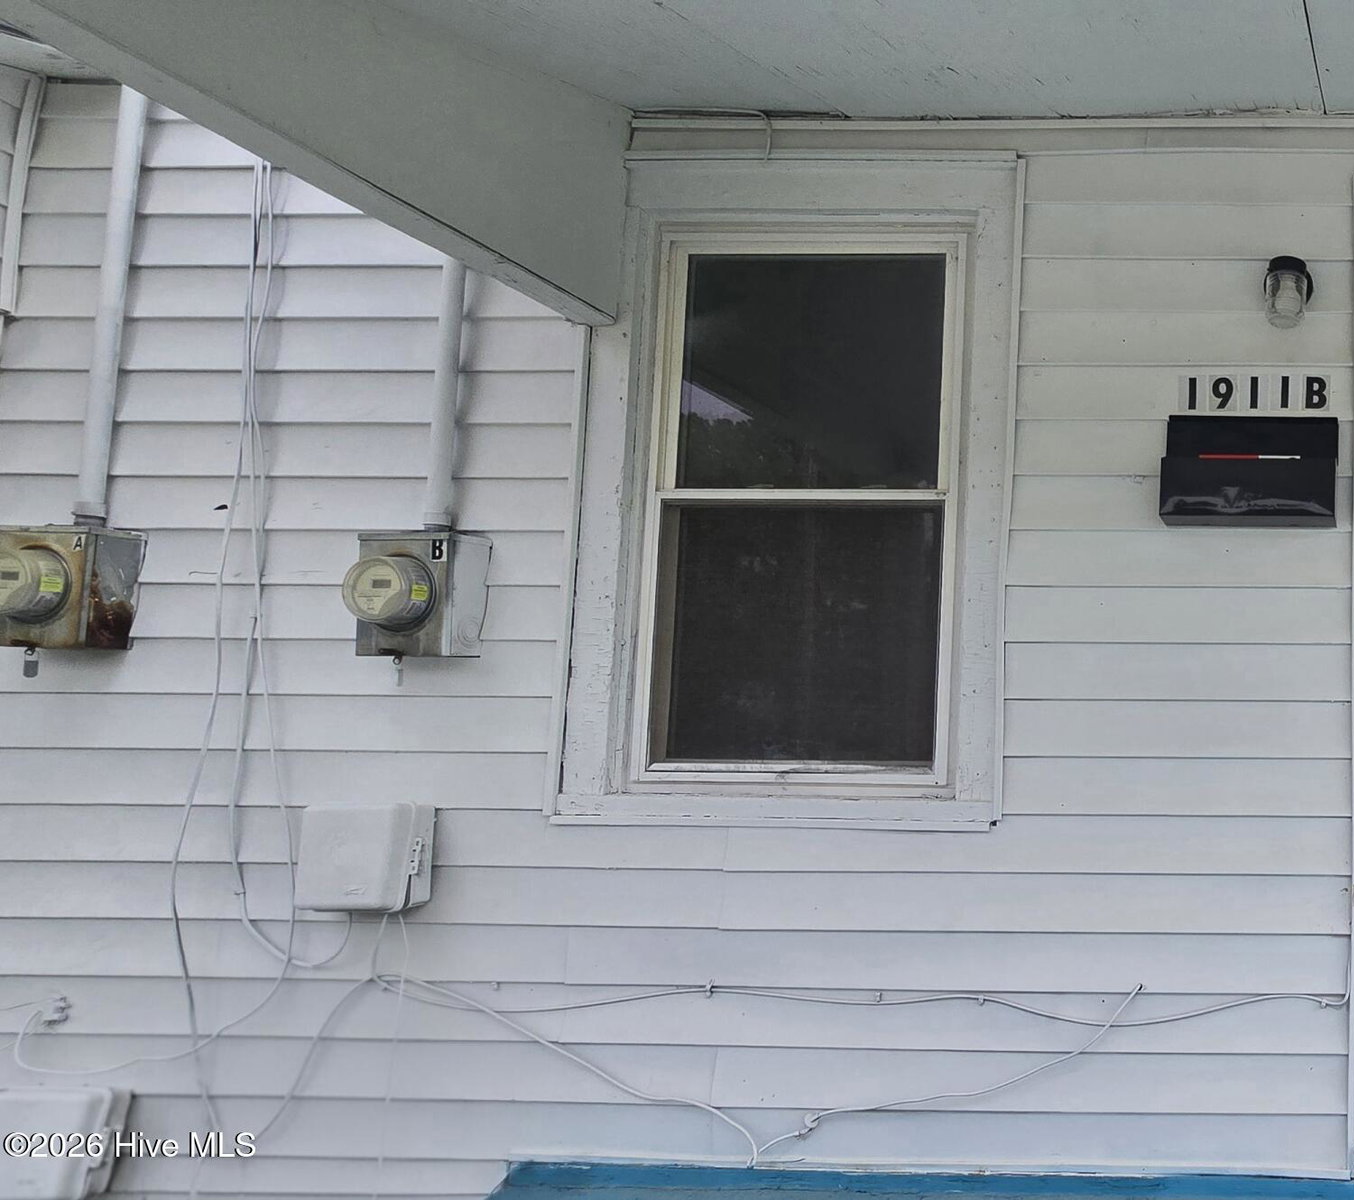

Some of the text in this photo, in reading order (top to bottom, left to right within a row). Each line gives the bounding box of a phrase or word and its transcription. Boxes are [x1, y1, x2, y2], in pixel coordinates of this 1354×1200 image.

[1188, 376, 1327, 410] 1911B
[73, 536, 83, 550] A
[431, 539, 444, 560] B
